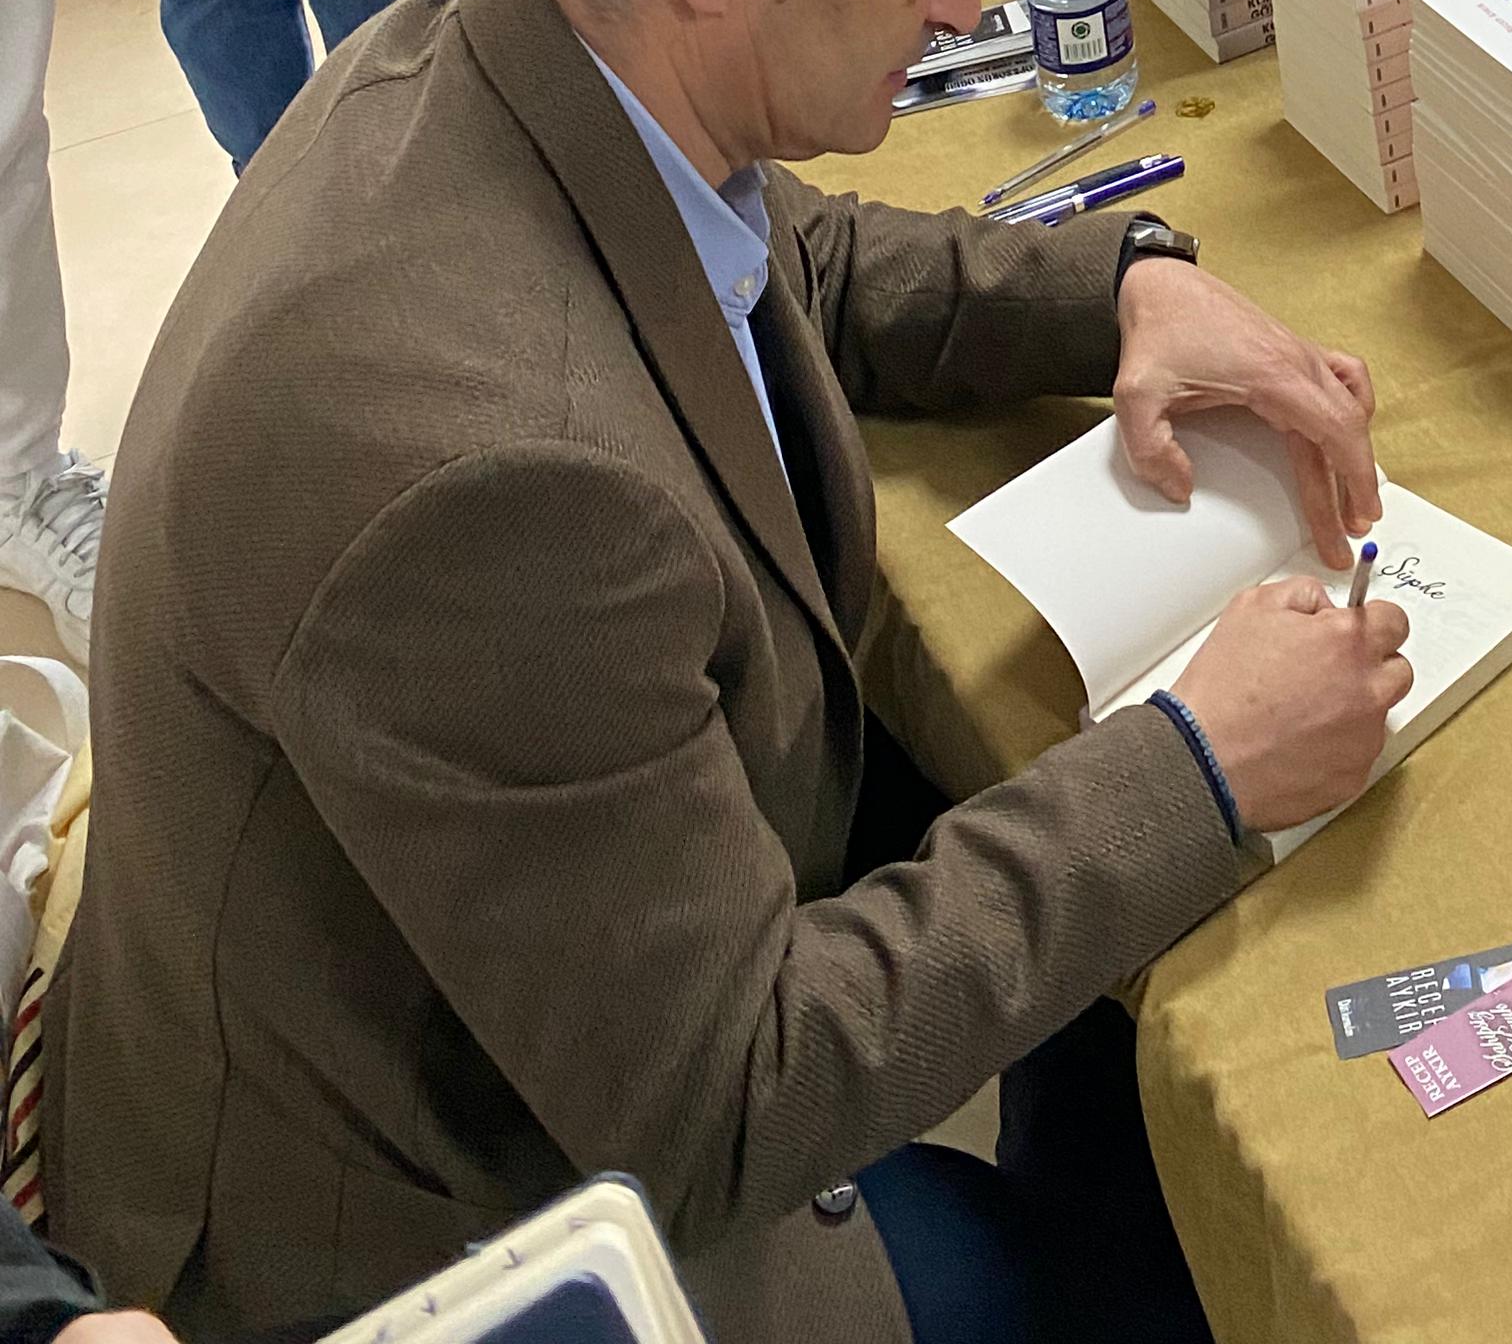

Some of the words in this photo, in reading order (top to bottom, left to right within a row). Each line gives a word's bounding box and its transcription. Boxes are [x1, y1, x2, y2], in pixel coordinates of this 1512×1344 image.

[1377, 556, 1446, 600] Şüphe
[1386, 975, 1423, 1034] AYKIR
[1404, 1055, 1445, 1102] RECEP
[1422, 1045, 1461, 1091] AYKIR
